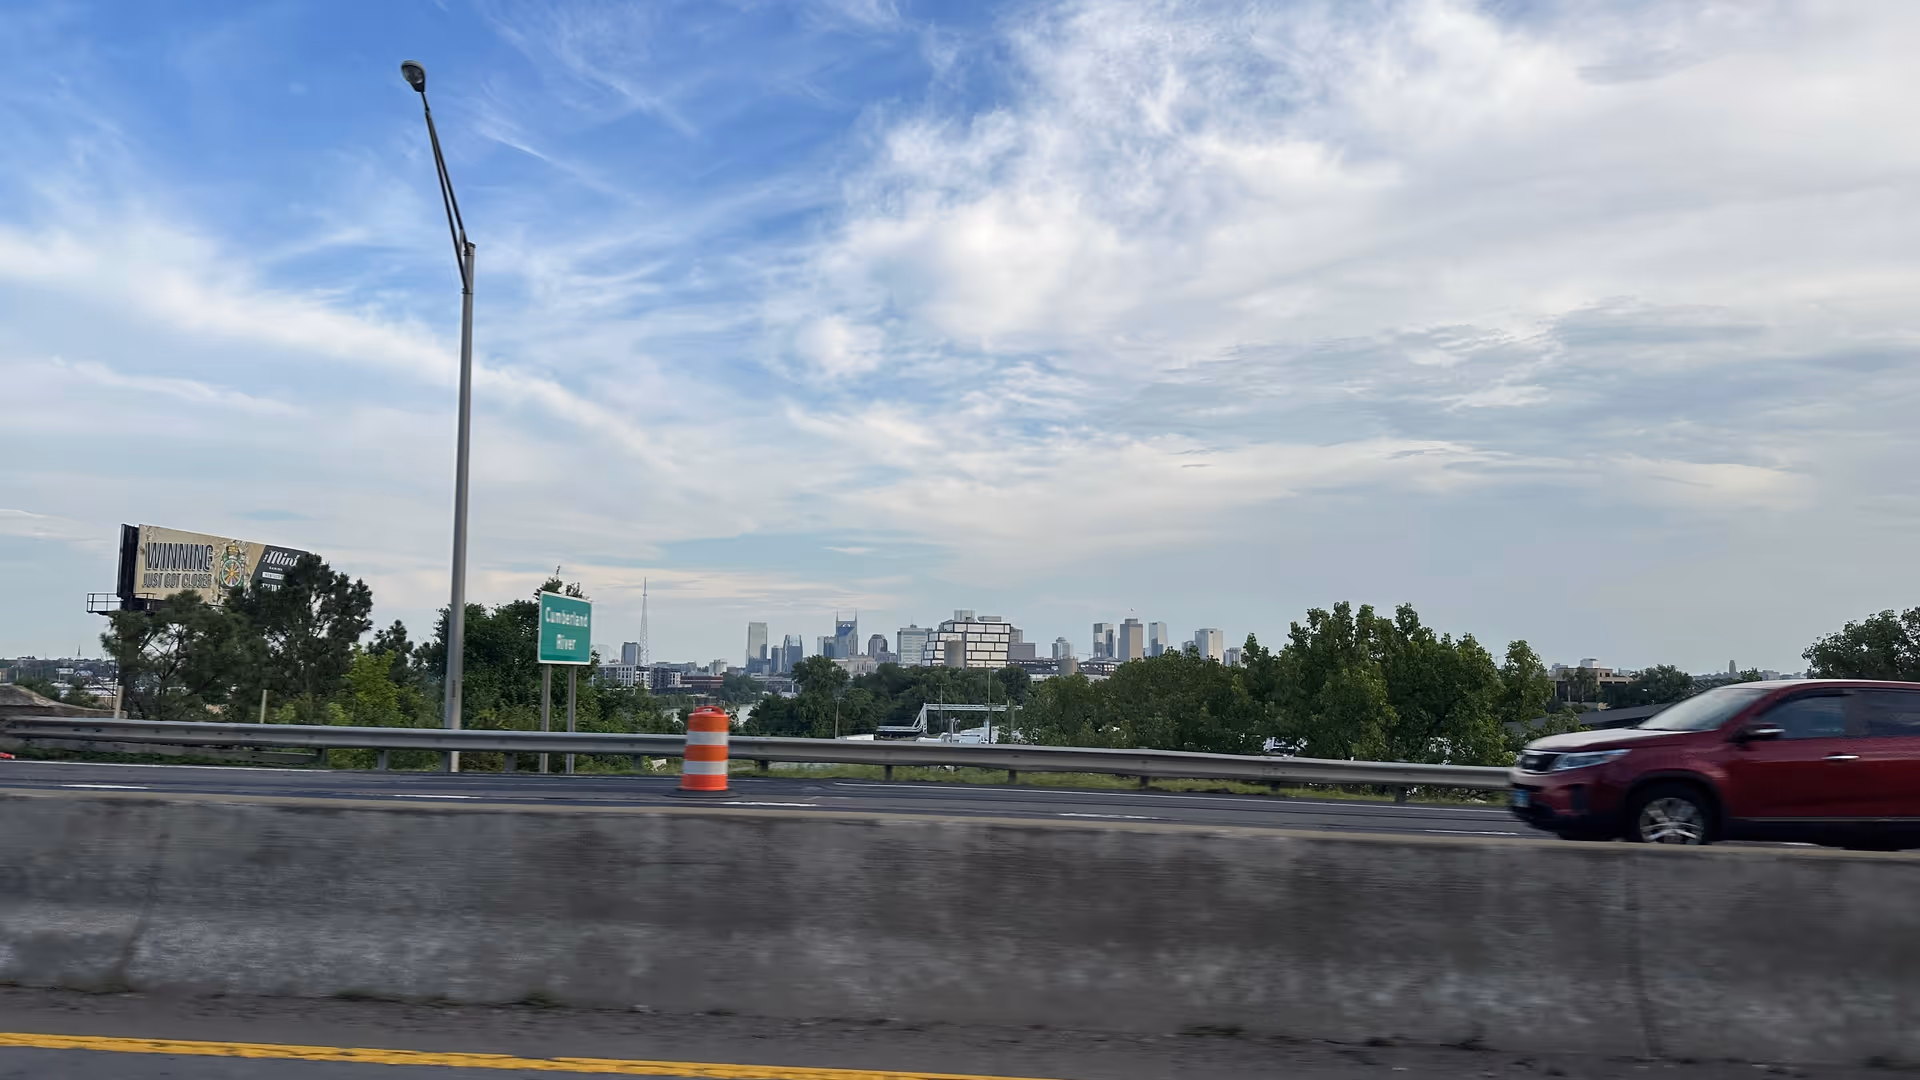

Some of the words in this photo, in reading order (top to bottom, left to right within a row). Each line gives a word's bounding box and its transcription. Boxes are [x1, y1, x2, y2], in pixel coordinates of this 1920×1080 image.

[145, 541, 213, 571] WINNING
[142, 573, 163, 588] JUST
[164, 573, 181, 588] GOT
[182, 574, 212, 588] CLOSER
[545, 606, 588, 628] Cumberland
[556, 633, 576, 650] River
